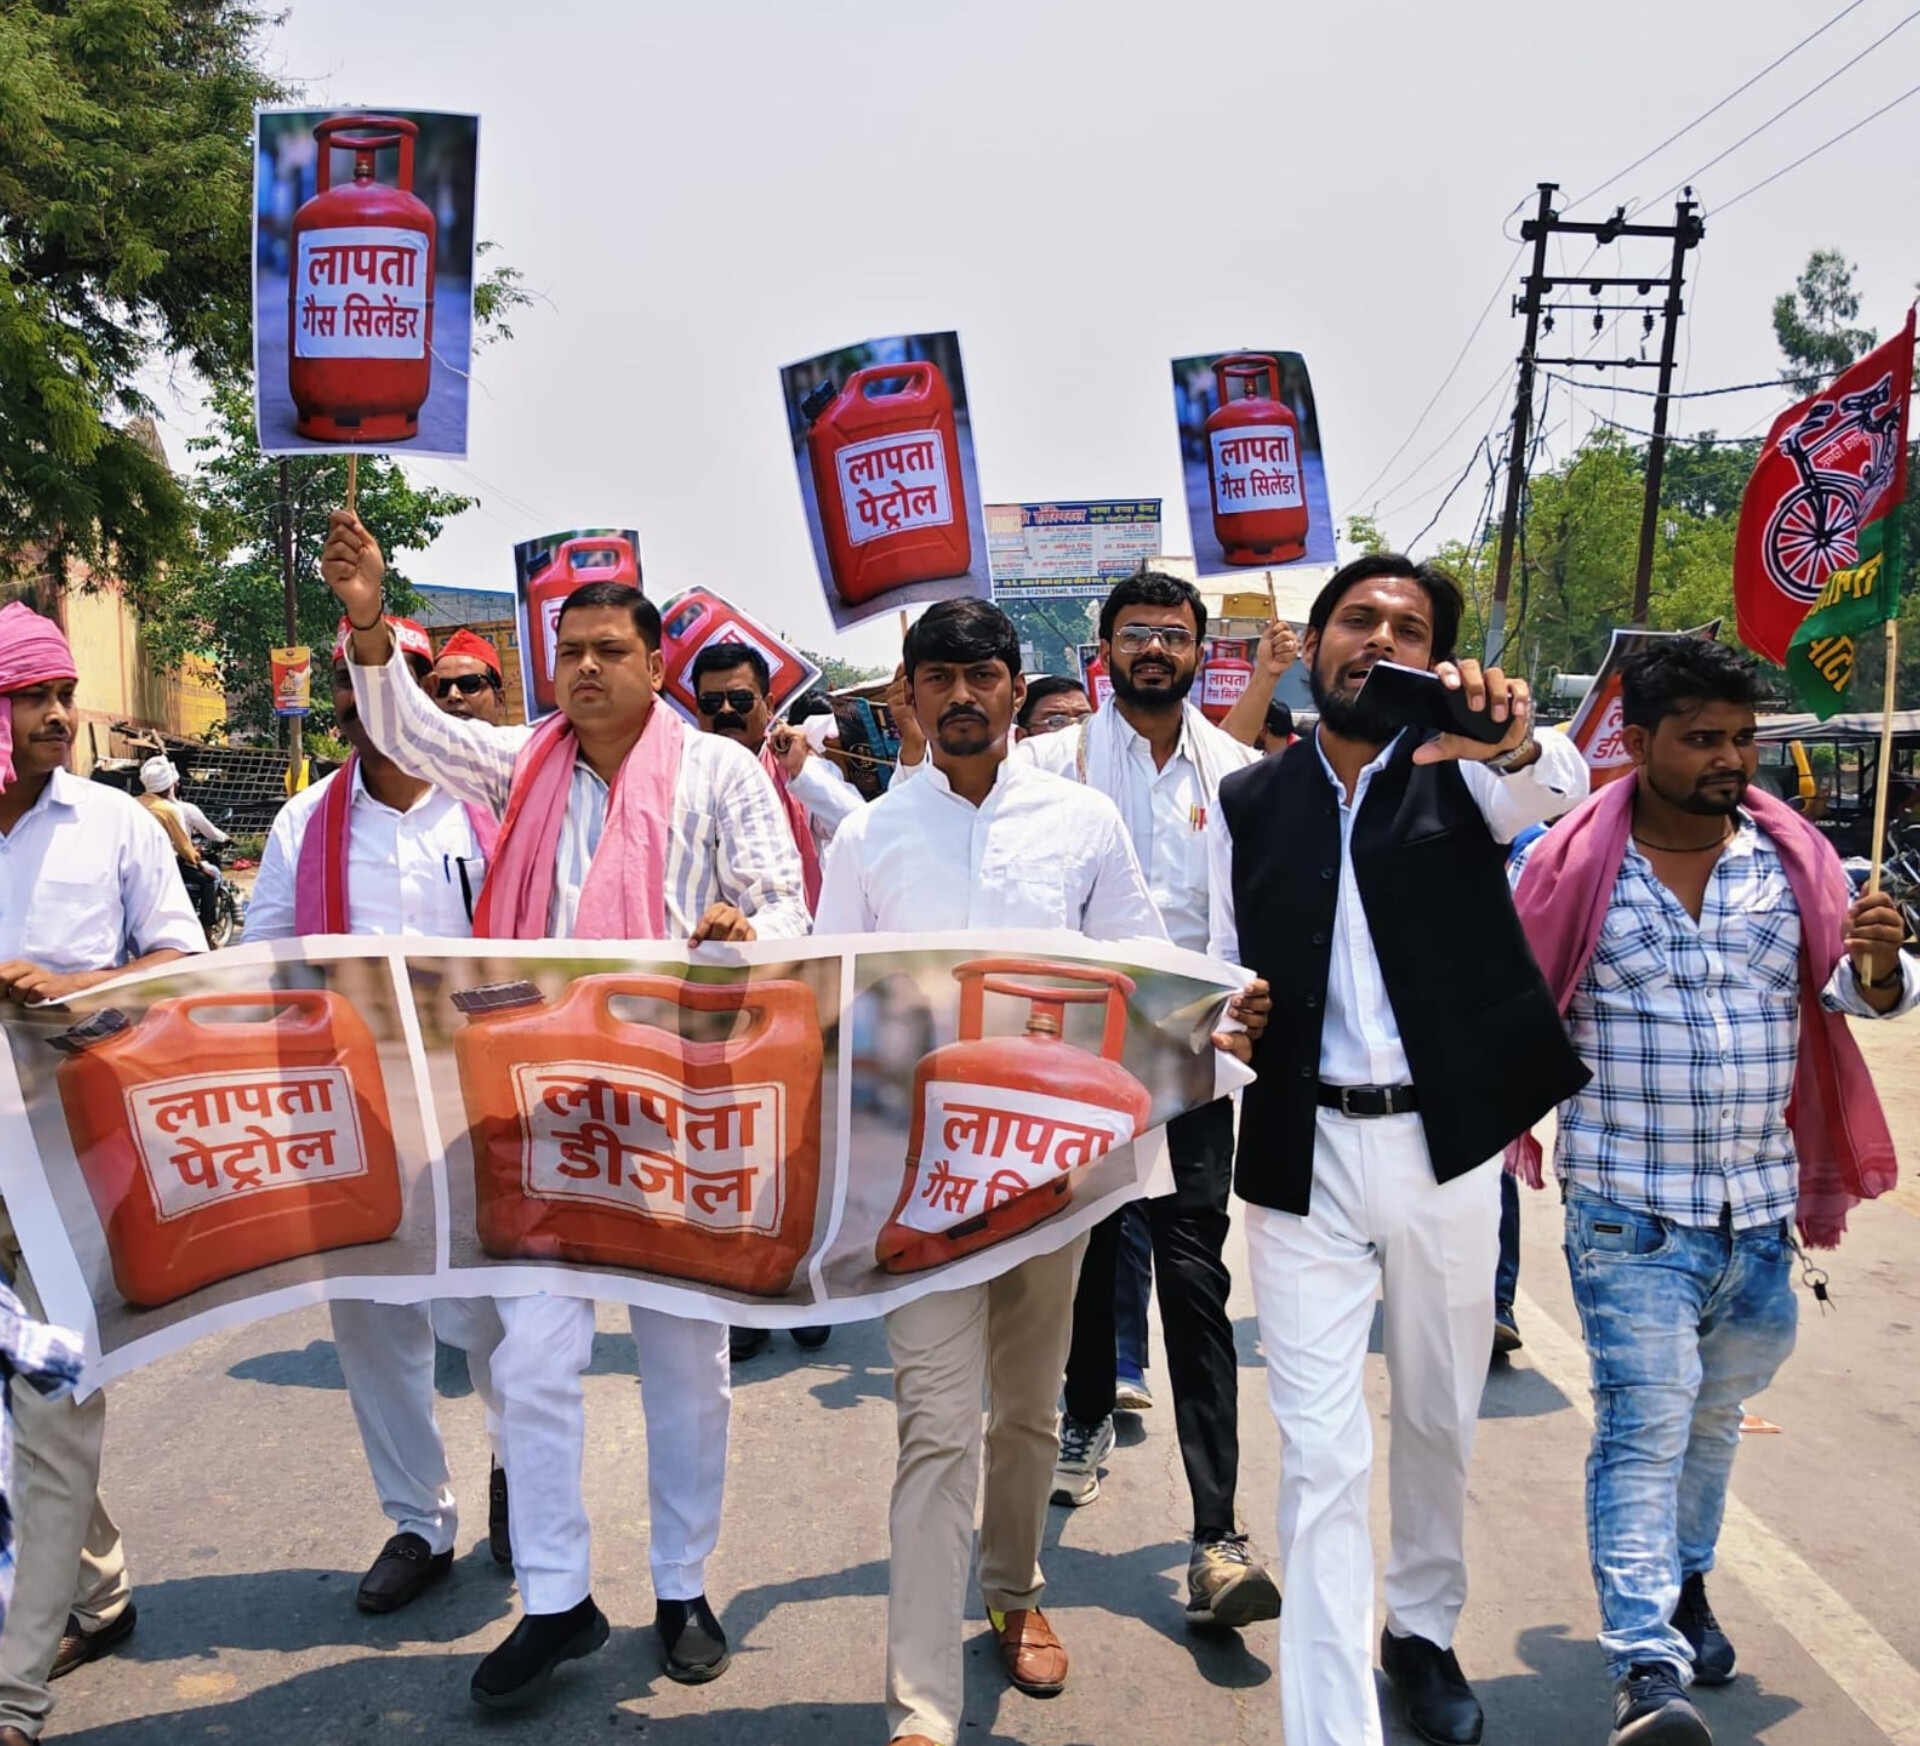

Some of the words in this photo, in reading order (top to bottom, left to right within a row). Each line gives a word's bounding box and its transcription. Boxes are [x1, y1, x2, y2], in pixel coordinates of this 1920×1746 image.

[308, 245, 417, 287] लापता
[302, 294, 337, 338] गैस
[344, 292, 419, 339] सिलेंडर
[846, 440, 934, 485] लापता
[1219, 436, 1290, 467] लापता
[856, 480, 937, 531] पेट्रोल
[1221, 472, 1246, 500] गैस
[1249, 468, 1296, 497] सिलेंडर
[1208, 673, 1246, 686] लापता
[148, 1078, 334, 1133] लापता
[536, 1074, 762, 1151] लापता
[169, 1125, 337, 1190] पेट्रोल
[943, 1102, 1115, 1170] लापता
[550, 1121, 759, 1215] डीजल
[921, 1159, 978, 1214] गैस
